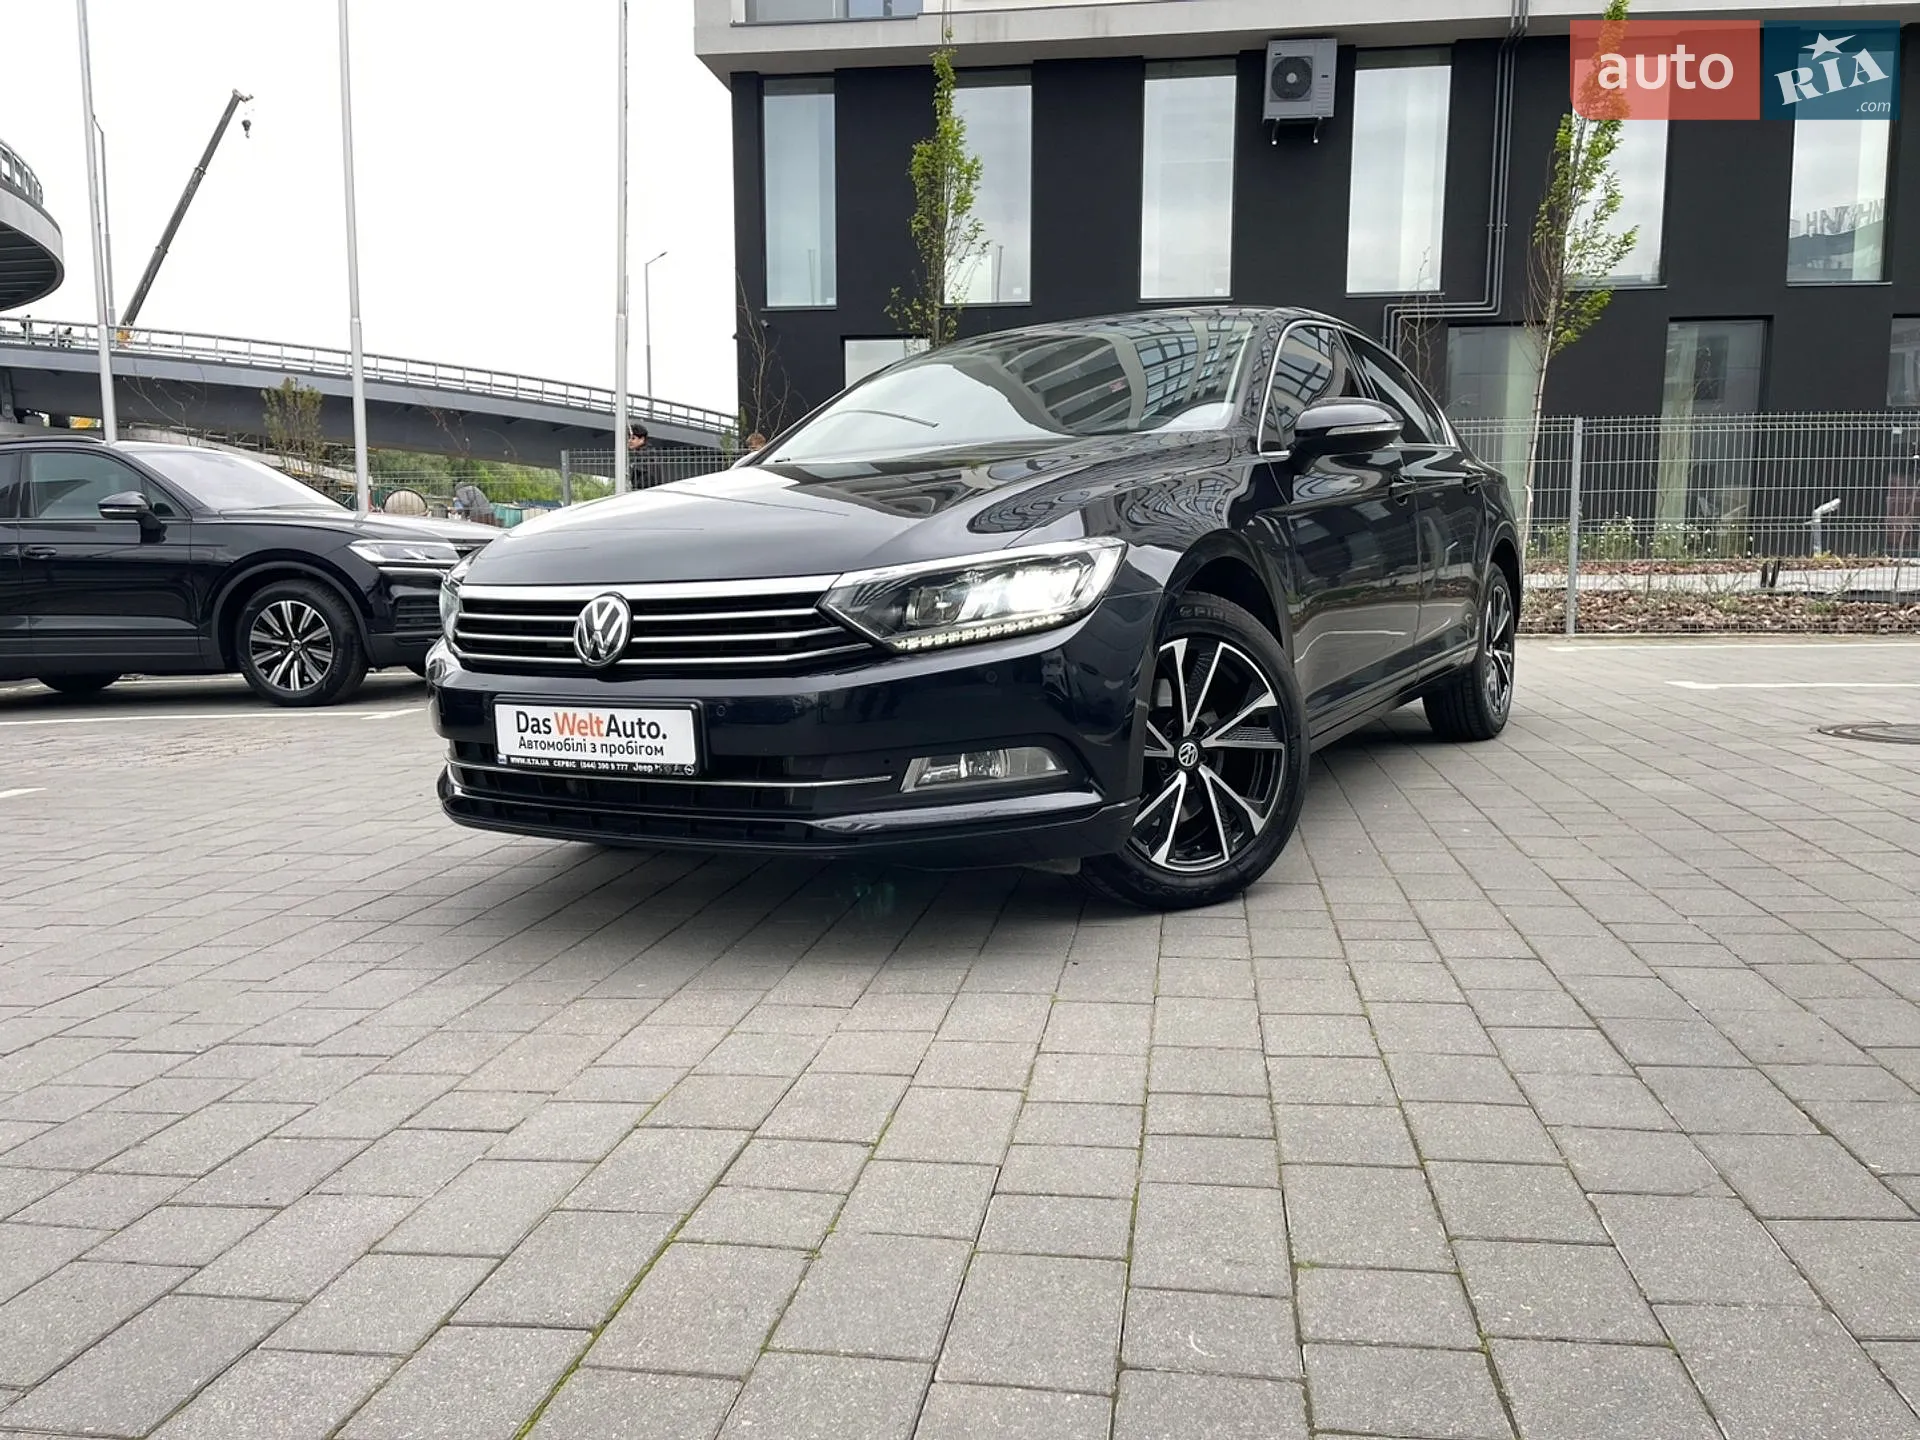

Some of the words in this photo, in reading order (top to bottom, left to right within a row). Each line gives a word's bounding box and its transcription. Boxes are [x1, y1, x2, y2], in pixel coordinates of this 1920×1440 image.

[518, 736, 587, 753] Автомобілі
[590, 743, 597, 753] з
[600, 740, 664, 757] пробігом
